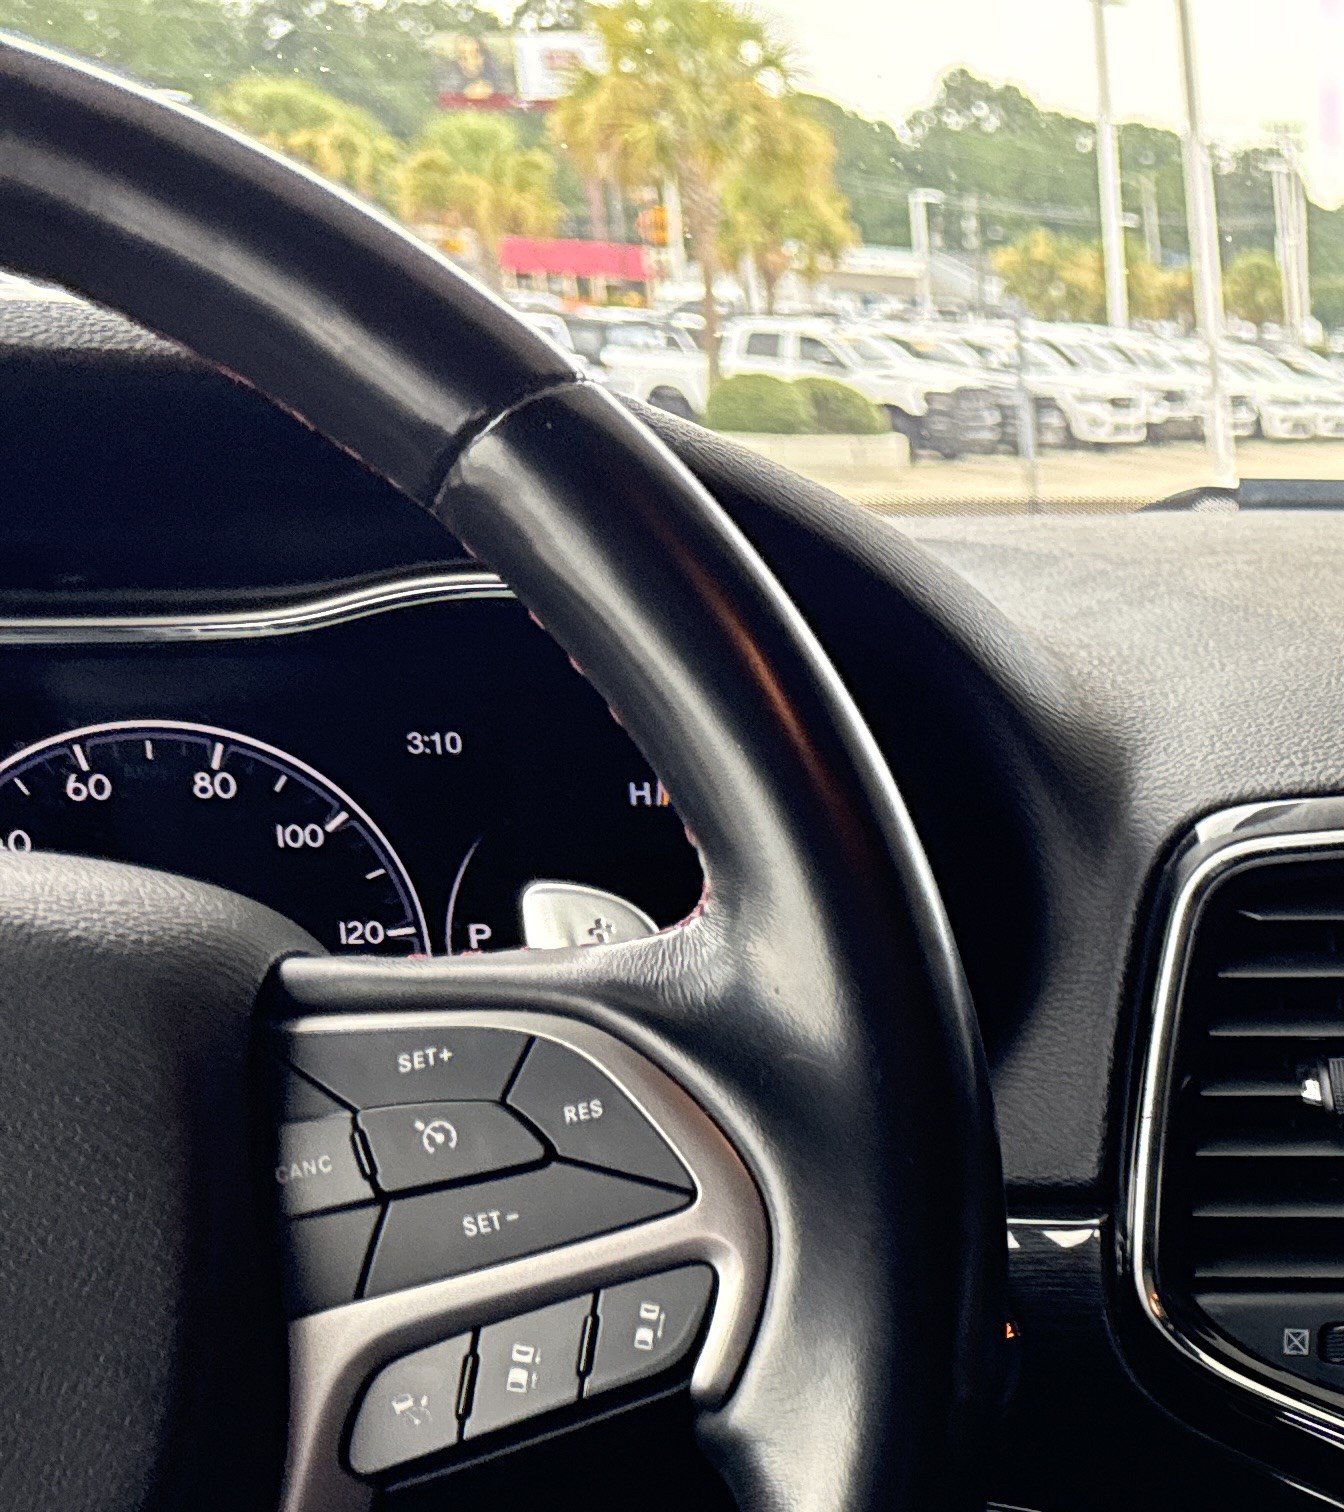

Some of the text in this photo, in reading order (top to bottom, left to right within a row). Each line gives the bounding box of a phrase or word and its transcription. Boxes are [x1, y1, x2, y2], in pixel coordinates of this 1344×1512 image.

[406, 731, 463, 755] 3:10
[65, 773, 112, 801] 60
[193, 772, 237, 799] 80
[0, 829, 32, 853] 0
[275, 824, 325, 848] 100
[339, 921, 385, 945] 120
[469, 924, 492, 948] P
[563, 1100, 604, 1125] RES
